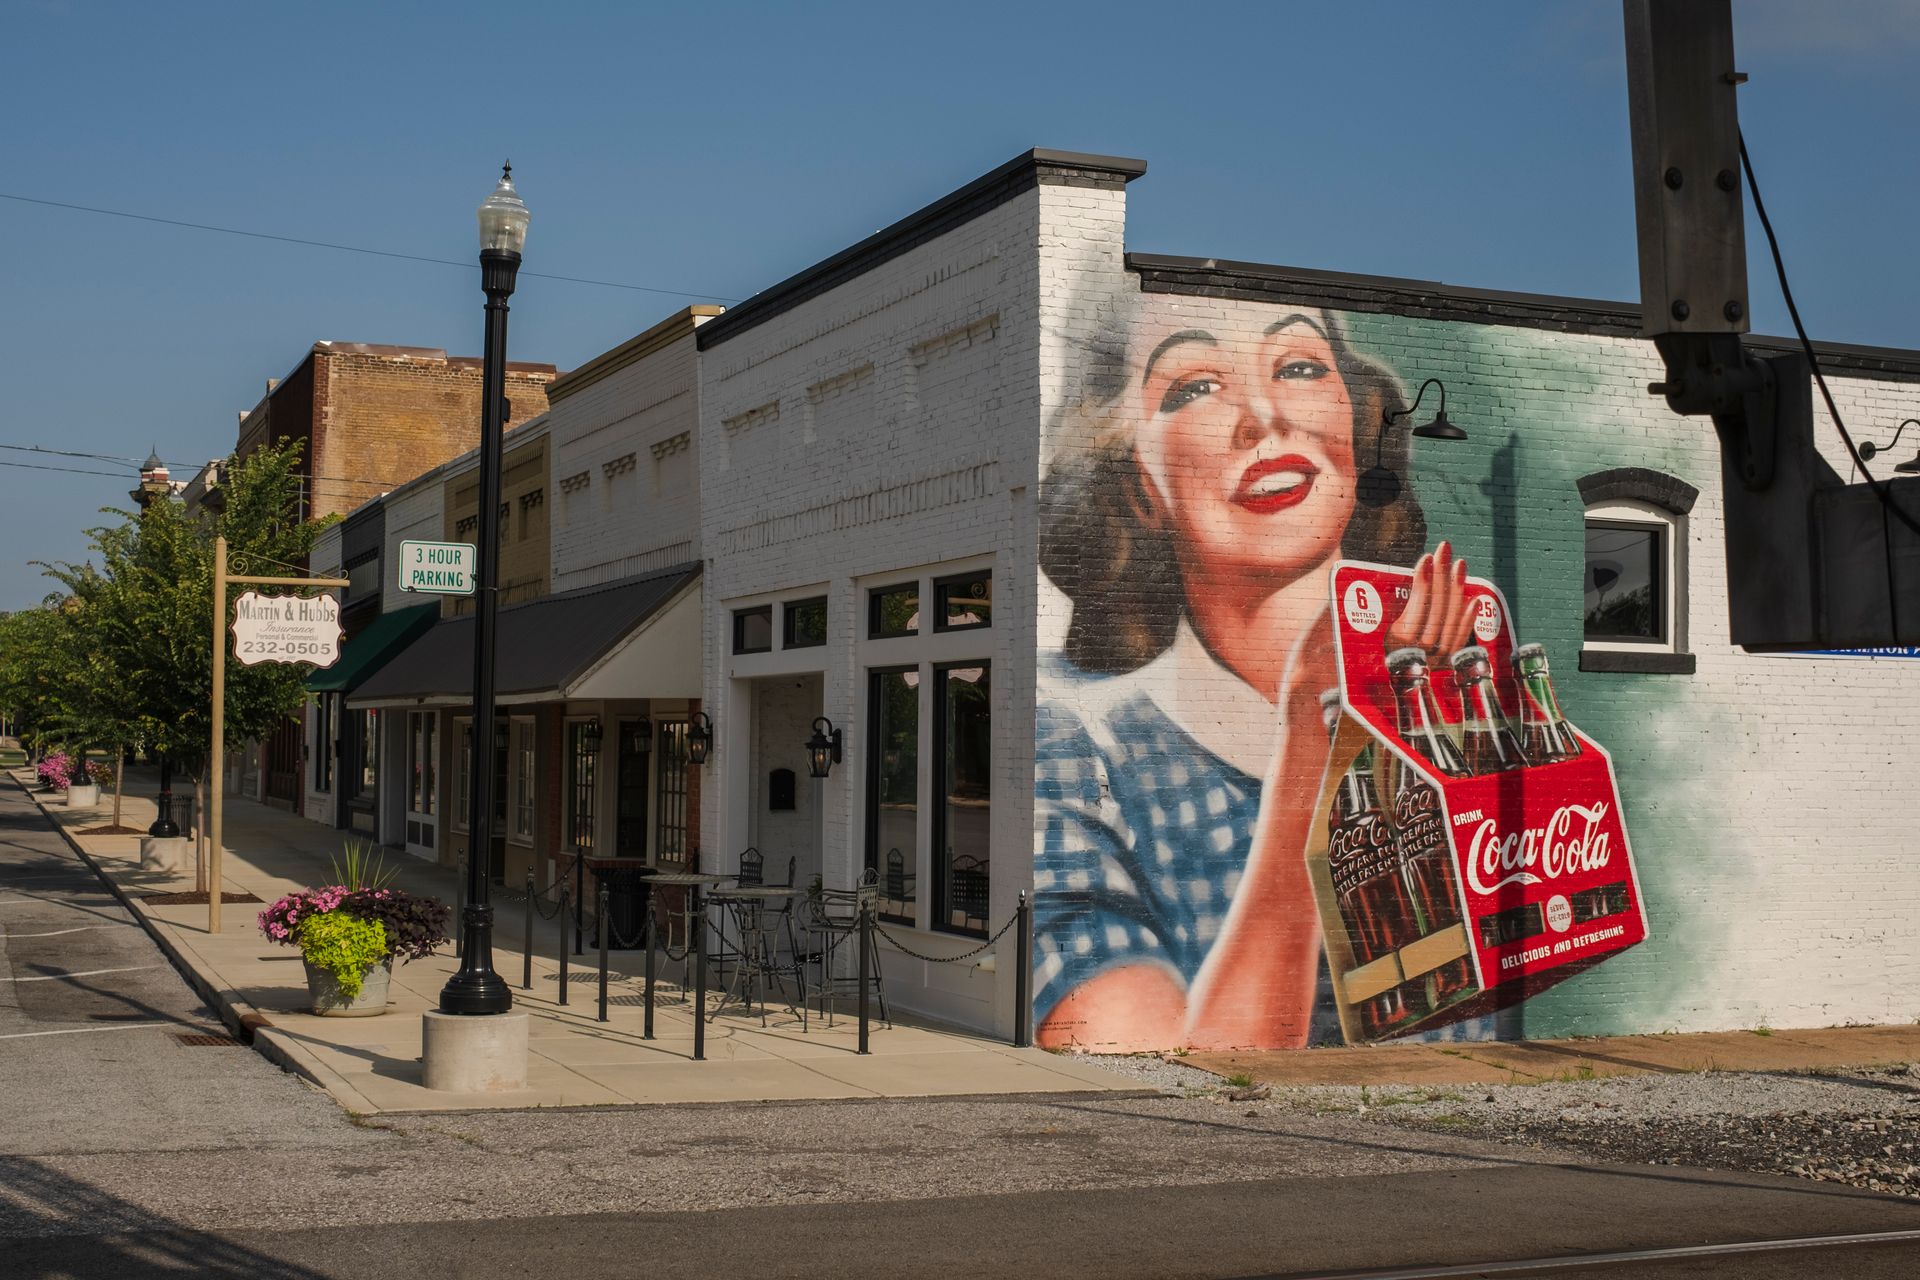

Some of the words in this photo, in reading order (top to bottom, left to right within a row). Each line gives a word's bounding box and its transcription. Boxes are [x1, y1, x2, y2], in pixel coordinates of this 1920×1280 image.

[415, 547, 423, 563] 3
[428, 548, 462, 565] HOUR
[412, 569, 464, 587] PARKING
[1355, 587, 1369, 610] 6
[1395, 586, 1411, 600] FO
[284, 601, 294, 621] &
[1351, 611, 1376, 619] BOTTLES
[260, 621, 315, 634] Insurance
[256, 633, 280, 641] Personal
[281, 633, 286, 641] &
[242, 641, 331, 655] 232-0505
[1453, 809, 1484, 826] DRINK
[1466, 801, 1611, 895] Coca-Cola
[1549, 903, 1565, 913] SERVE
[1548, 912, 1570, 923] ICE-COLD
[1501, 945, 1551, 969] DELICIOUS
[1553, 940, 1572, 954] AND
[1573, 925, 1624, 948] REFRESHING
